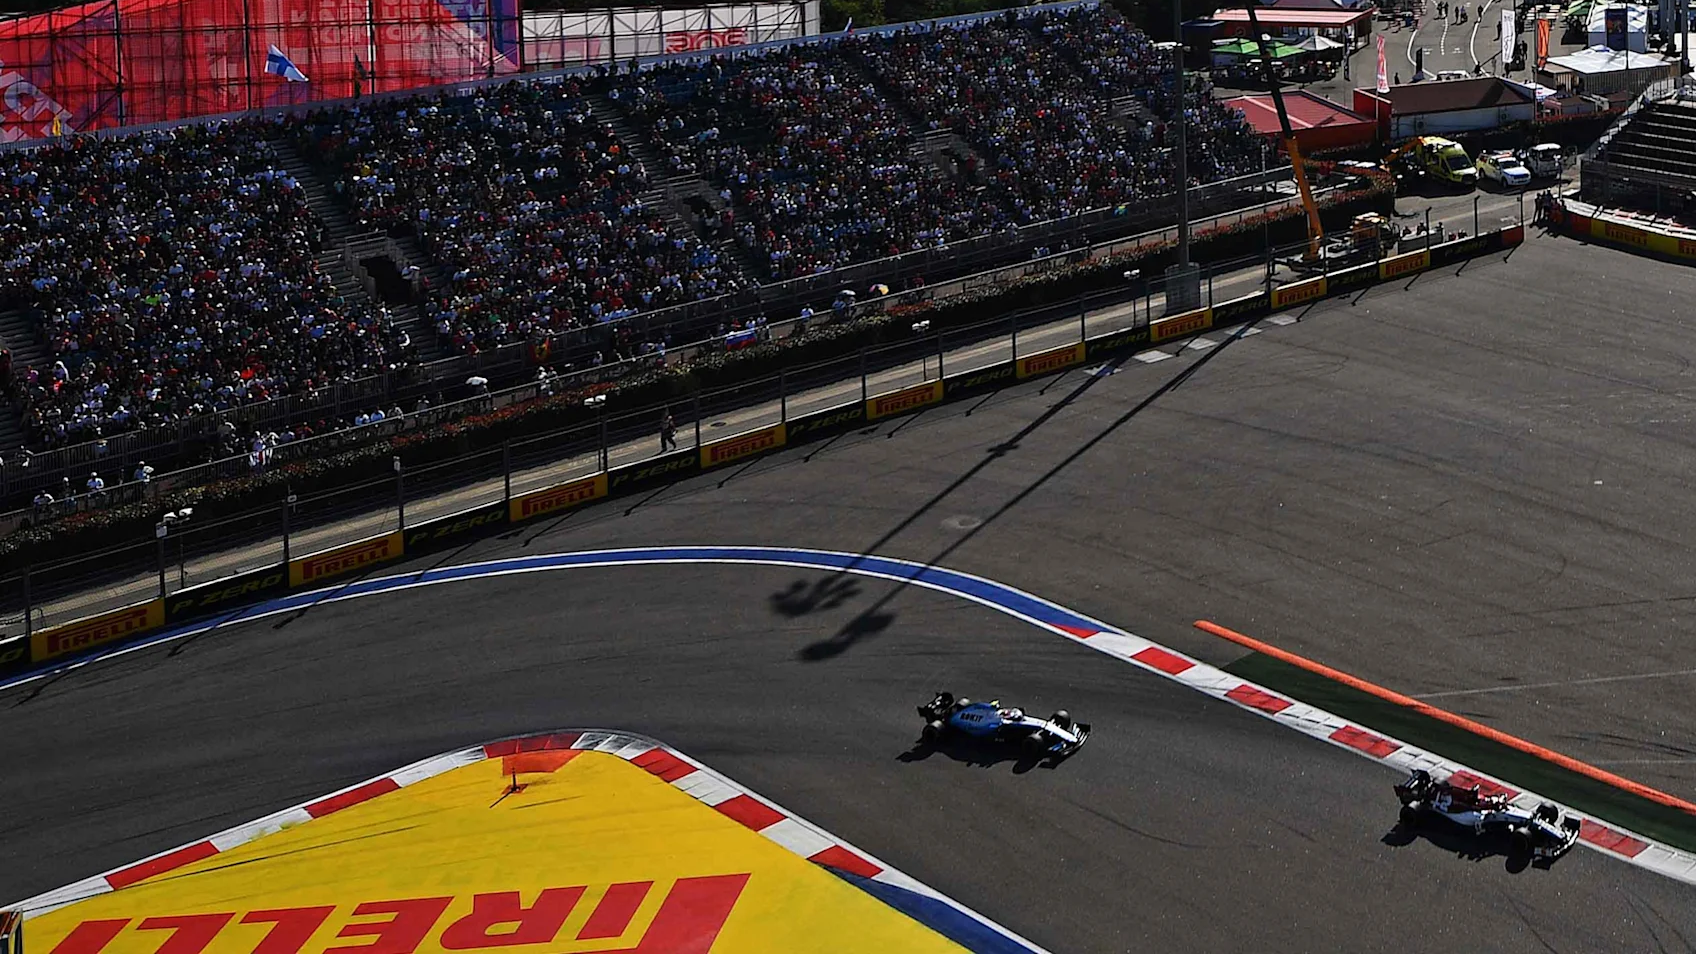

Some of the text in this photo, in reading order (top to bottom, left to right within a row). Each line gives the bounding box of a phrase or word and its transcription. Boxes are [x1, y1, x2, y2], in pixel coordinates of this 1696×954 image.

[1605, 223, 1647, 245] PIRELLI
[1385, 256, 1424, 276] PIRELLI
[1278, 282, 1319, 304] PIRELLI
[1158, 315, 1204, 338] PIRELLI
[1025, 348, 1076, 373] PIRELLI
[947, 367, 1013, 393] P ZERO
[876, 386, 934, 414] PIRELLI
[790, 409, 863, 435] P ZERO
[711, 430, 775, 462] PIRELLI
[612, 456, 696, 487] P ZERO
[522, 481, 595, 516] PIRELLI
[409, 510, 505, 545] P ZERO
[303, 539, 388, 580] PIRELLI
[172, 573, 284, 616] P ZERO
[47, 608, 148, 651] PIRELLI
[48, 873, 752, 954] PIRELLI
